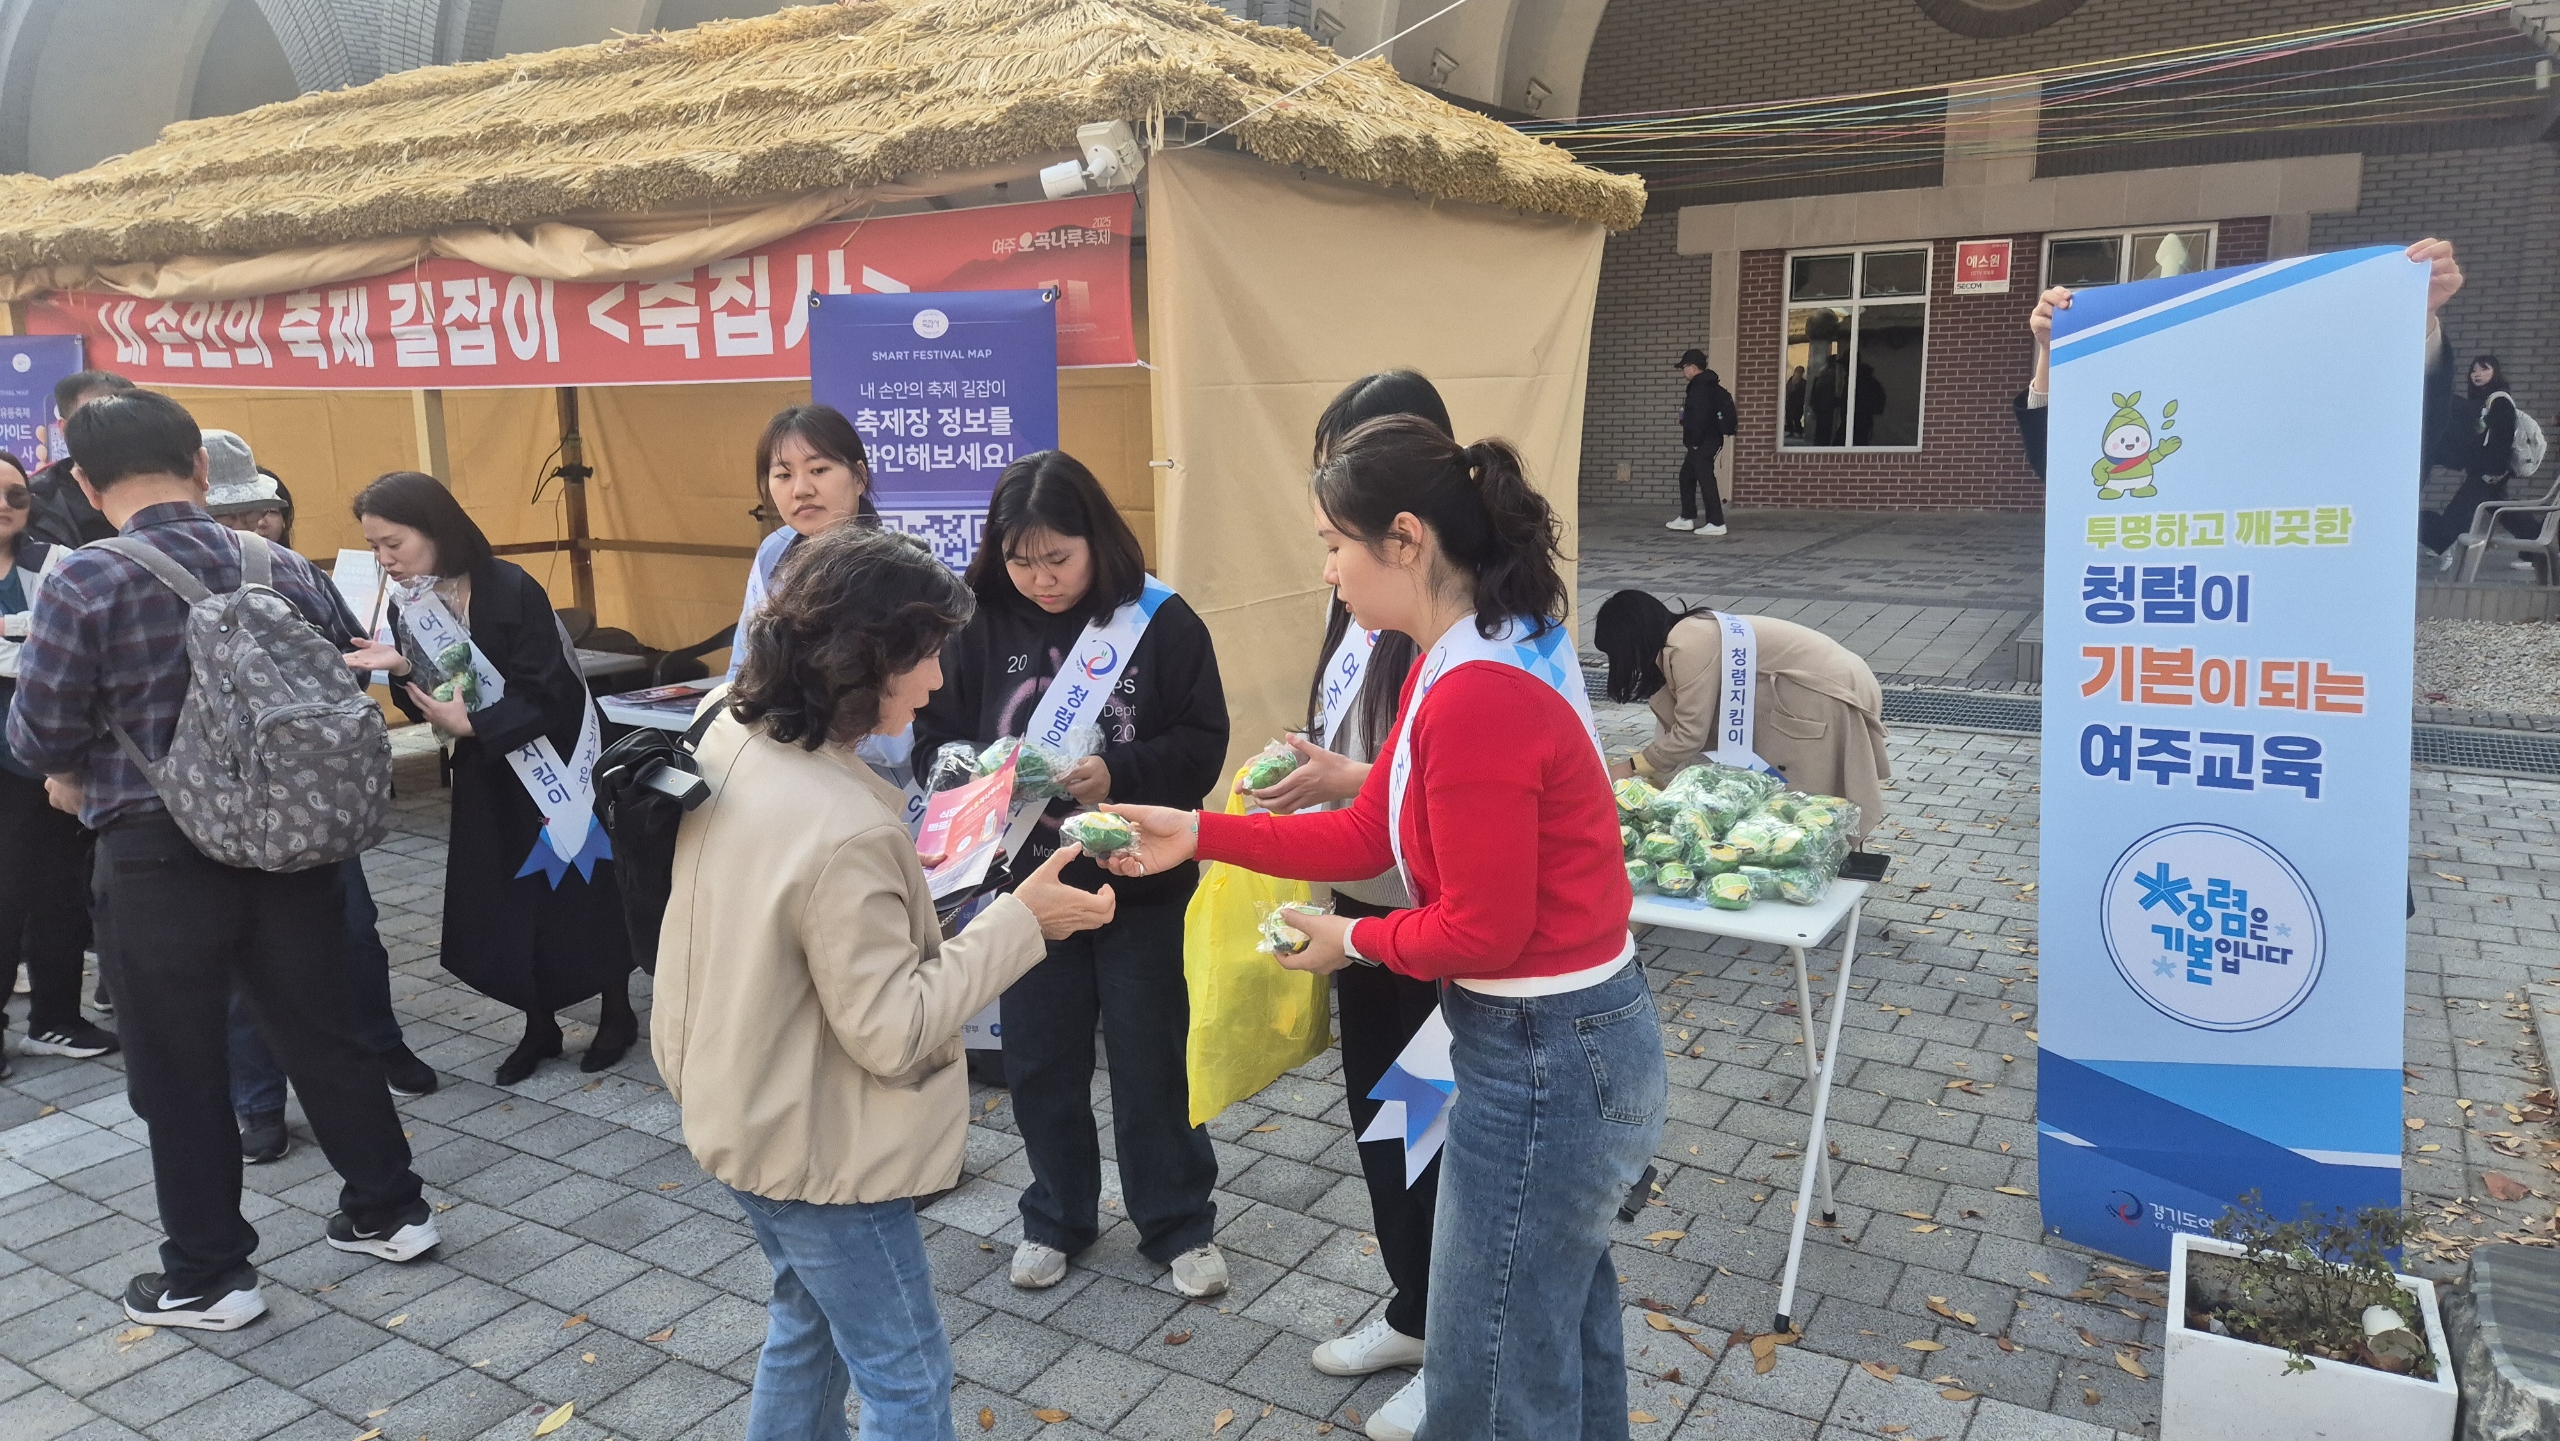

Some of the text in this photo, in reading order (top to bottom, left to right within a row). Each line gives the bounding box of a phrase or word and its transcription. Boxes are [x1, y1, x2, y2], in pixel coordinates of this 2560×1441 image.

[1092, 216, 1112, 228] 2025
[992, 237, 1017, 254] 여주
[1966, 254, 2001, 268] 에스원
[97, 300, 147, 367] 내
[144, 296, 273, 370] 손안의
[279, 285, 375, 370] 축제
[388, 274, 561, 368] 길잡이
[871, 348, 993, 361] SMART FESTIVAL MAP
[860, 377, 1006, 400] 내 손안의 축제 길잡이
[855, 404, 1013, 438] 축제장 정보를
[2086, 506, 2353, 550] 투명하고 깨끗한
[2082, 564, 2250, 625] 청렴이
[1007, 654, 1028, 673] 20
[2081, 645, 2365, 714] 기본이 되는
[1041, 684, 1089, 748] 청렴이
[1103, 704, 1136, 718] Dept
[1728, 647, 1747, 746] 청렴지킴이
[1112, 724, 1136, 742] 20
[2080, 722, 2323, 800] 여주교육
[2133, 862, 2269, 943] 청렴은
[2151, 923, 2294, 986] 기본입니다
